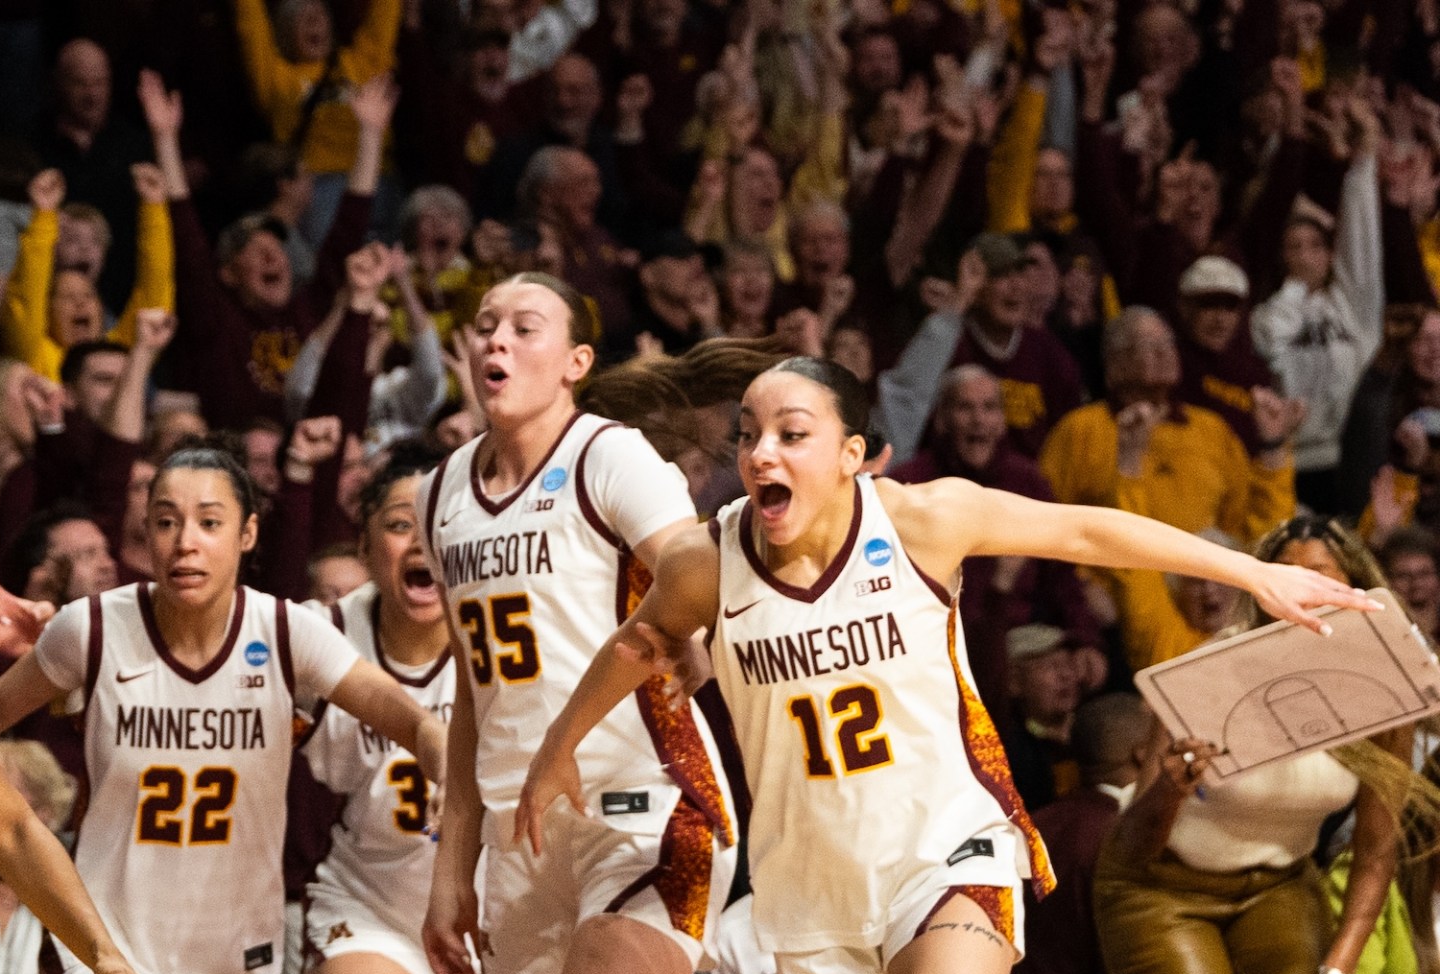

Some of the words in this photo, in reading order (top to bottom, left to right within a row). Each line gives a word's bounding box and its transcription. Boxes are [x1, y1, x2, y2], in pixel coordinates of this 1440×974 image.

[439, 530, 553, 588] MINNESOTA
[459, 592, 542, 687] 35
[733, 612, 906, 686] MINNESOTA
[115, 704, 265, 750] MINNESOTA
[786, 682, 895, 780] 12
[135, 765, 240, 847] 22
